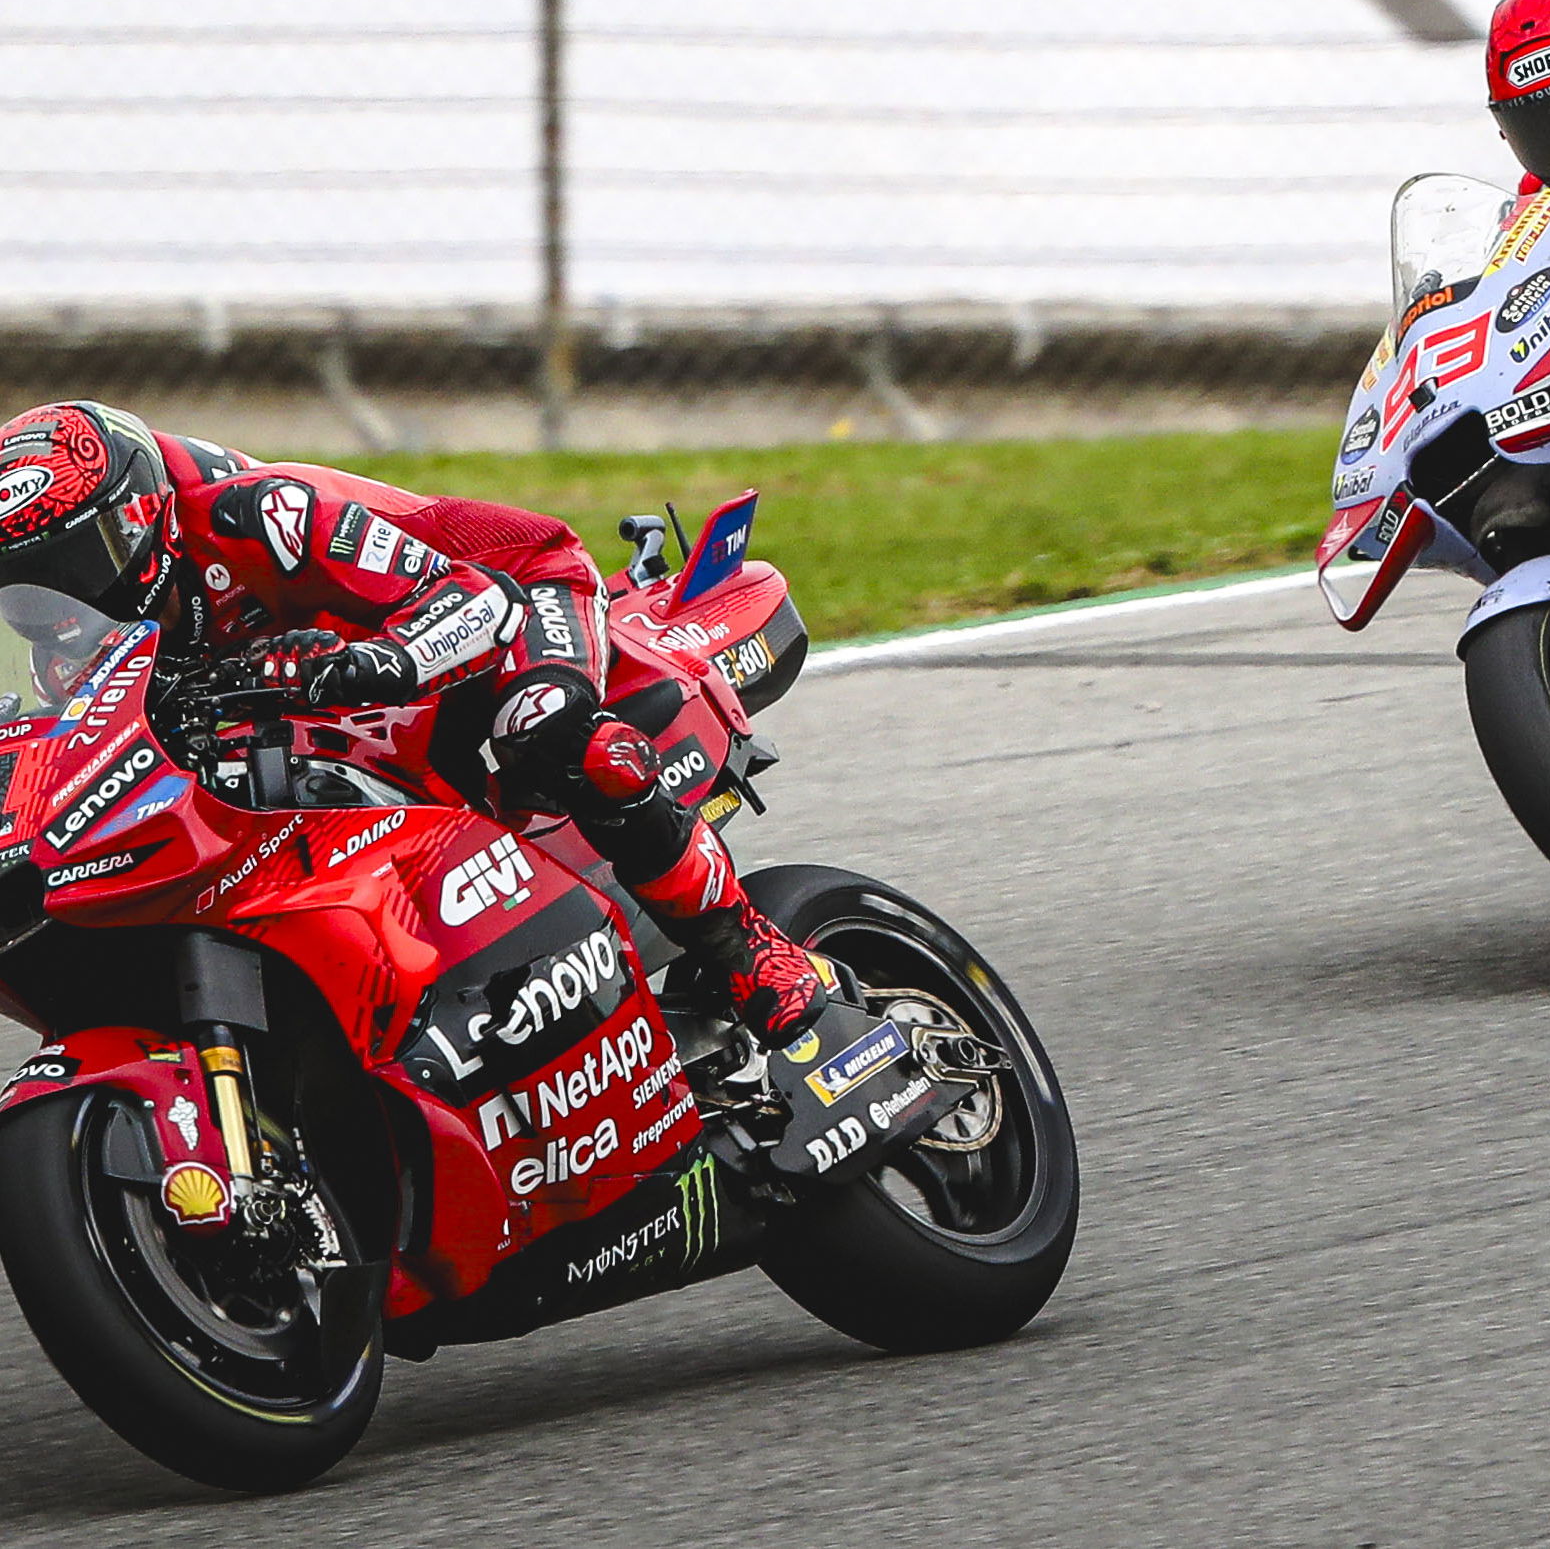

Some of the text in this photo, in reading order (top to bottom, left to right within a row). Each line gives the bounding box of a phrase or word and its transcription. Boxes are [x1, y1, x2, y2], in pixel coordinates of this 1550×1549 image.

[4, 432, 47, 447] Lenovo
[1485, 390, 1550, 429] BOLD
[725, 524, 748, 557] TIM
[137, 553, 172, 615] Lenovo
[396, 592, 464, 638] Lenovo
[189, 595, 204, 645] Lenovo
[415, 599, 496, 663] UnipolSai
[531, 587, 576, 658] Lenovo
[89, 623, 150, 691] ADVANCE
[706, 632, 777, 689] EX-BOX
[87, 654, 152, 729] riello
[52, 721, 142, 808] FRECCIAROSSA
[45, 745, 156, 850] Lenovo
[136, 796, 176, 822] TIM
[219, 813, 304, 895] Audi Sport
[346, 809, 406, 857] DAIKO
[47, 852, 134, 887] CARRERA
[440, 831, 536, 927] GIVI
[426, 930, 617, 1081] Lenovo
[538, 1015, 653, 1129] NetApp
[632, 1050, 682, 1110] SIEMENS
[632, 1091, 694, 1154] streparava
[805, 1116, 868, 1174] D.I.D
[510, 1117, 619, 1196] elica
[567, 1205, 681, 1283] MONSTER
